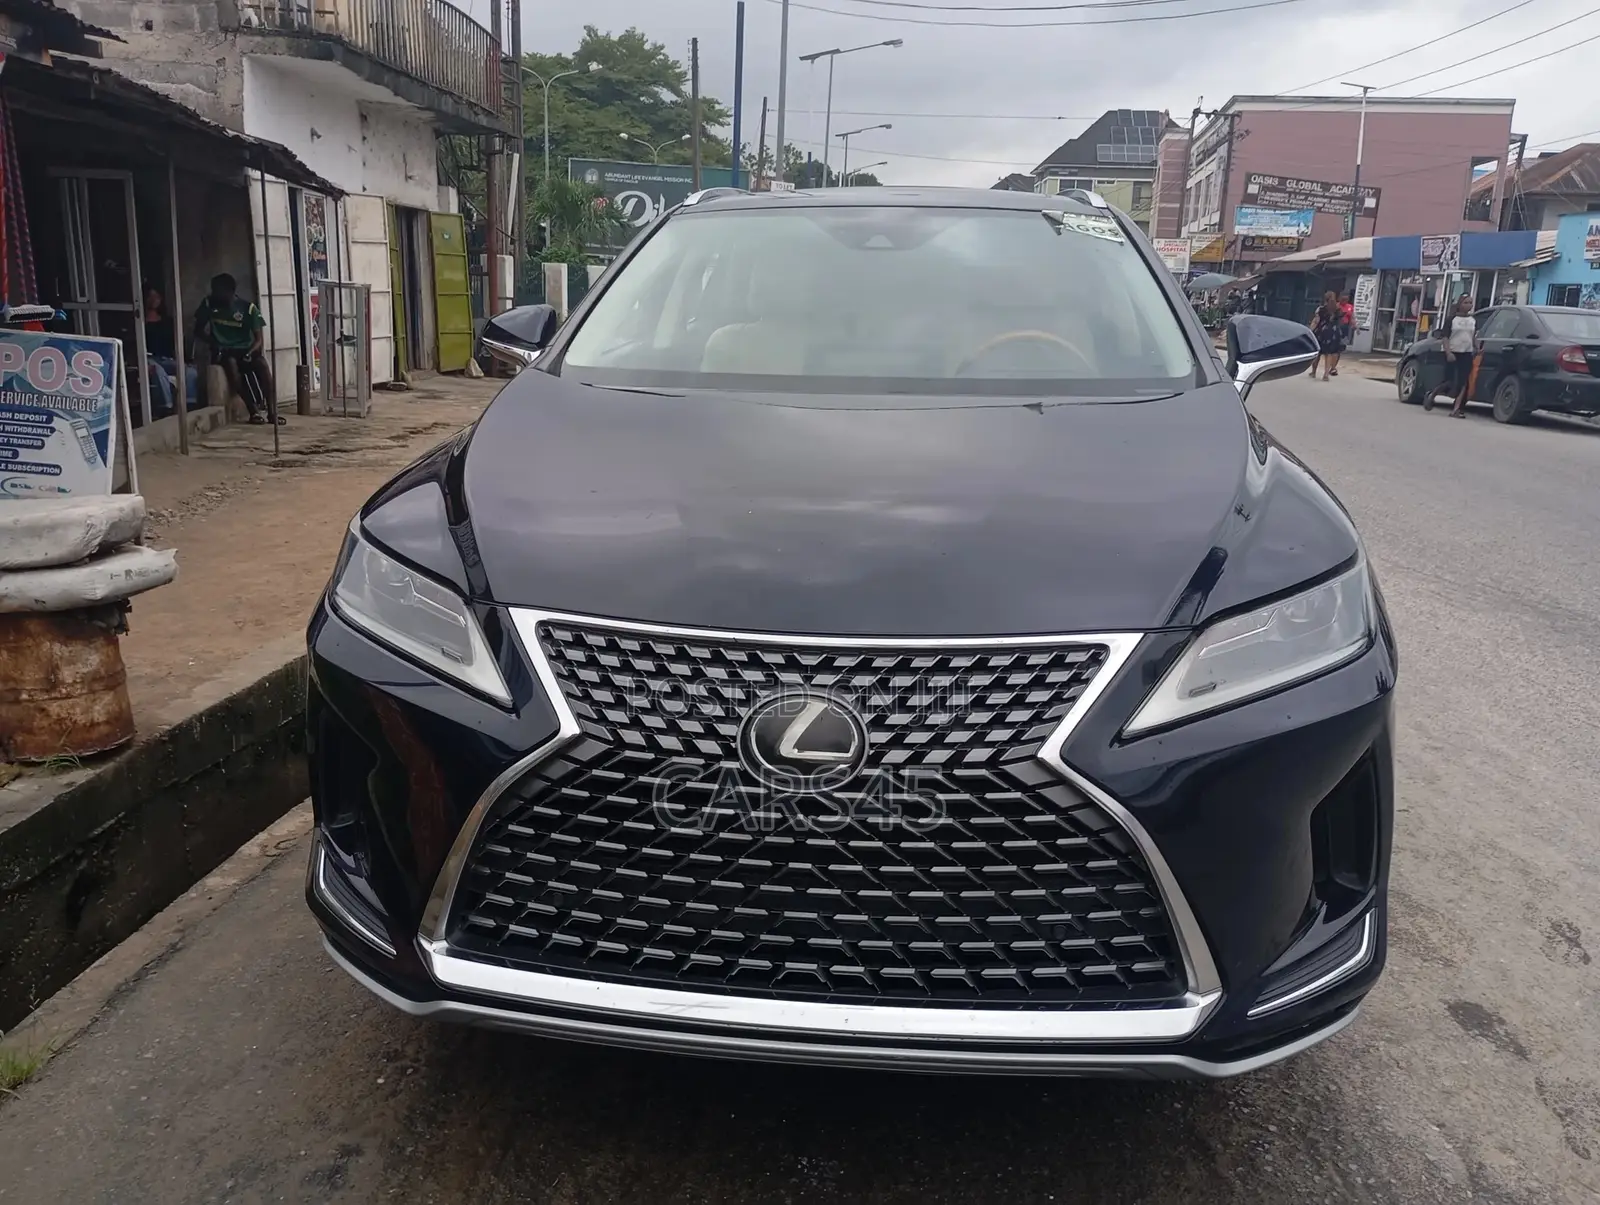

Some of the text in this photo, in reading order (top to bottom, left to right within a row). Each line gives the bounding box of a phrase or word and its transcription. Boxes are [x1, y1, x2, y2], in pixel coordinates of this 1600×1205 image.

[1251, 174, 1279, 186] OASIS
[1286, 179, 1323, 192] GLOBAL
[1329, 184, 1376, 198] ACADMY
[0, 343, 104, 396] POS
[41, 395, 98, 412] AVAILABLE
[14, 412, 47, 422] DEPOSIT
[4, 425, 52, 435] WITHDRAWAL
[9, 438, 42, 446] TRANSFER
[7, 463, 60, 474] SUBSCRIPTION
